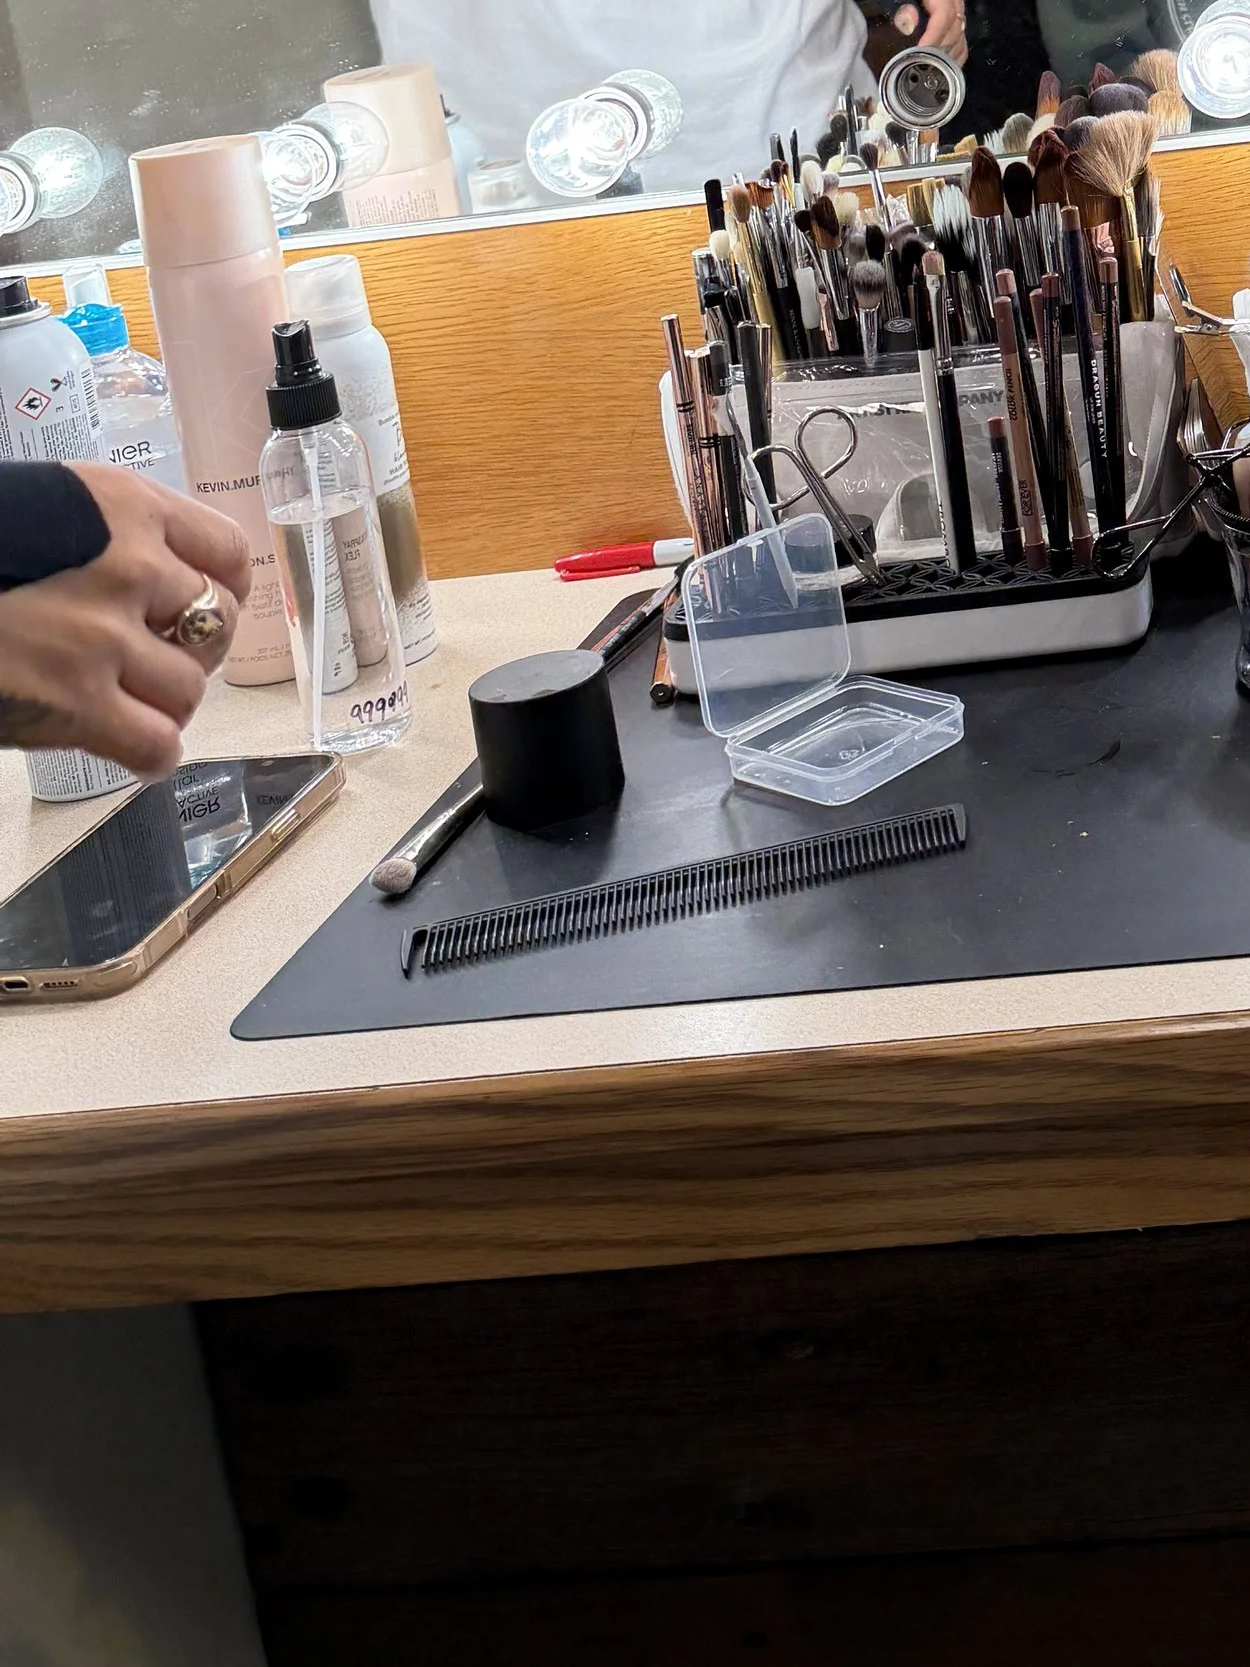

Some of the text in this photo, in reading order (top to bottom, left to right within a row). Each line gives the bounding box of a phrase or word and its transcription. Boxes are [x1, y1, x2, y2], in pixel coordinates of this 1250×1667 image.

[958, 390, 1004, 406] PANY
[1090, 359, 1102, 407] DRAGUN
[1096, 410, 1108, 459] BEAUTY
